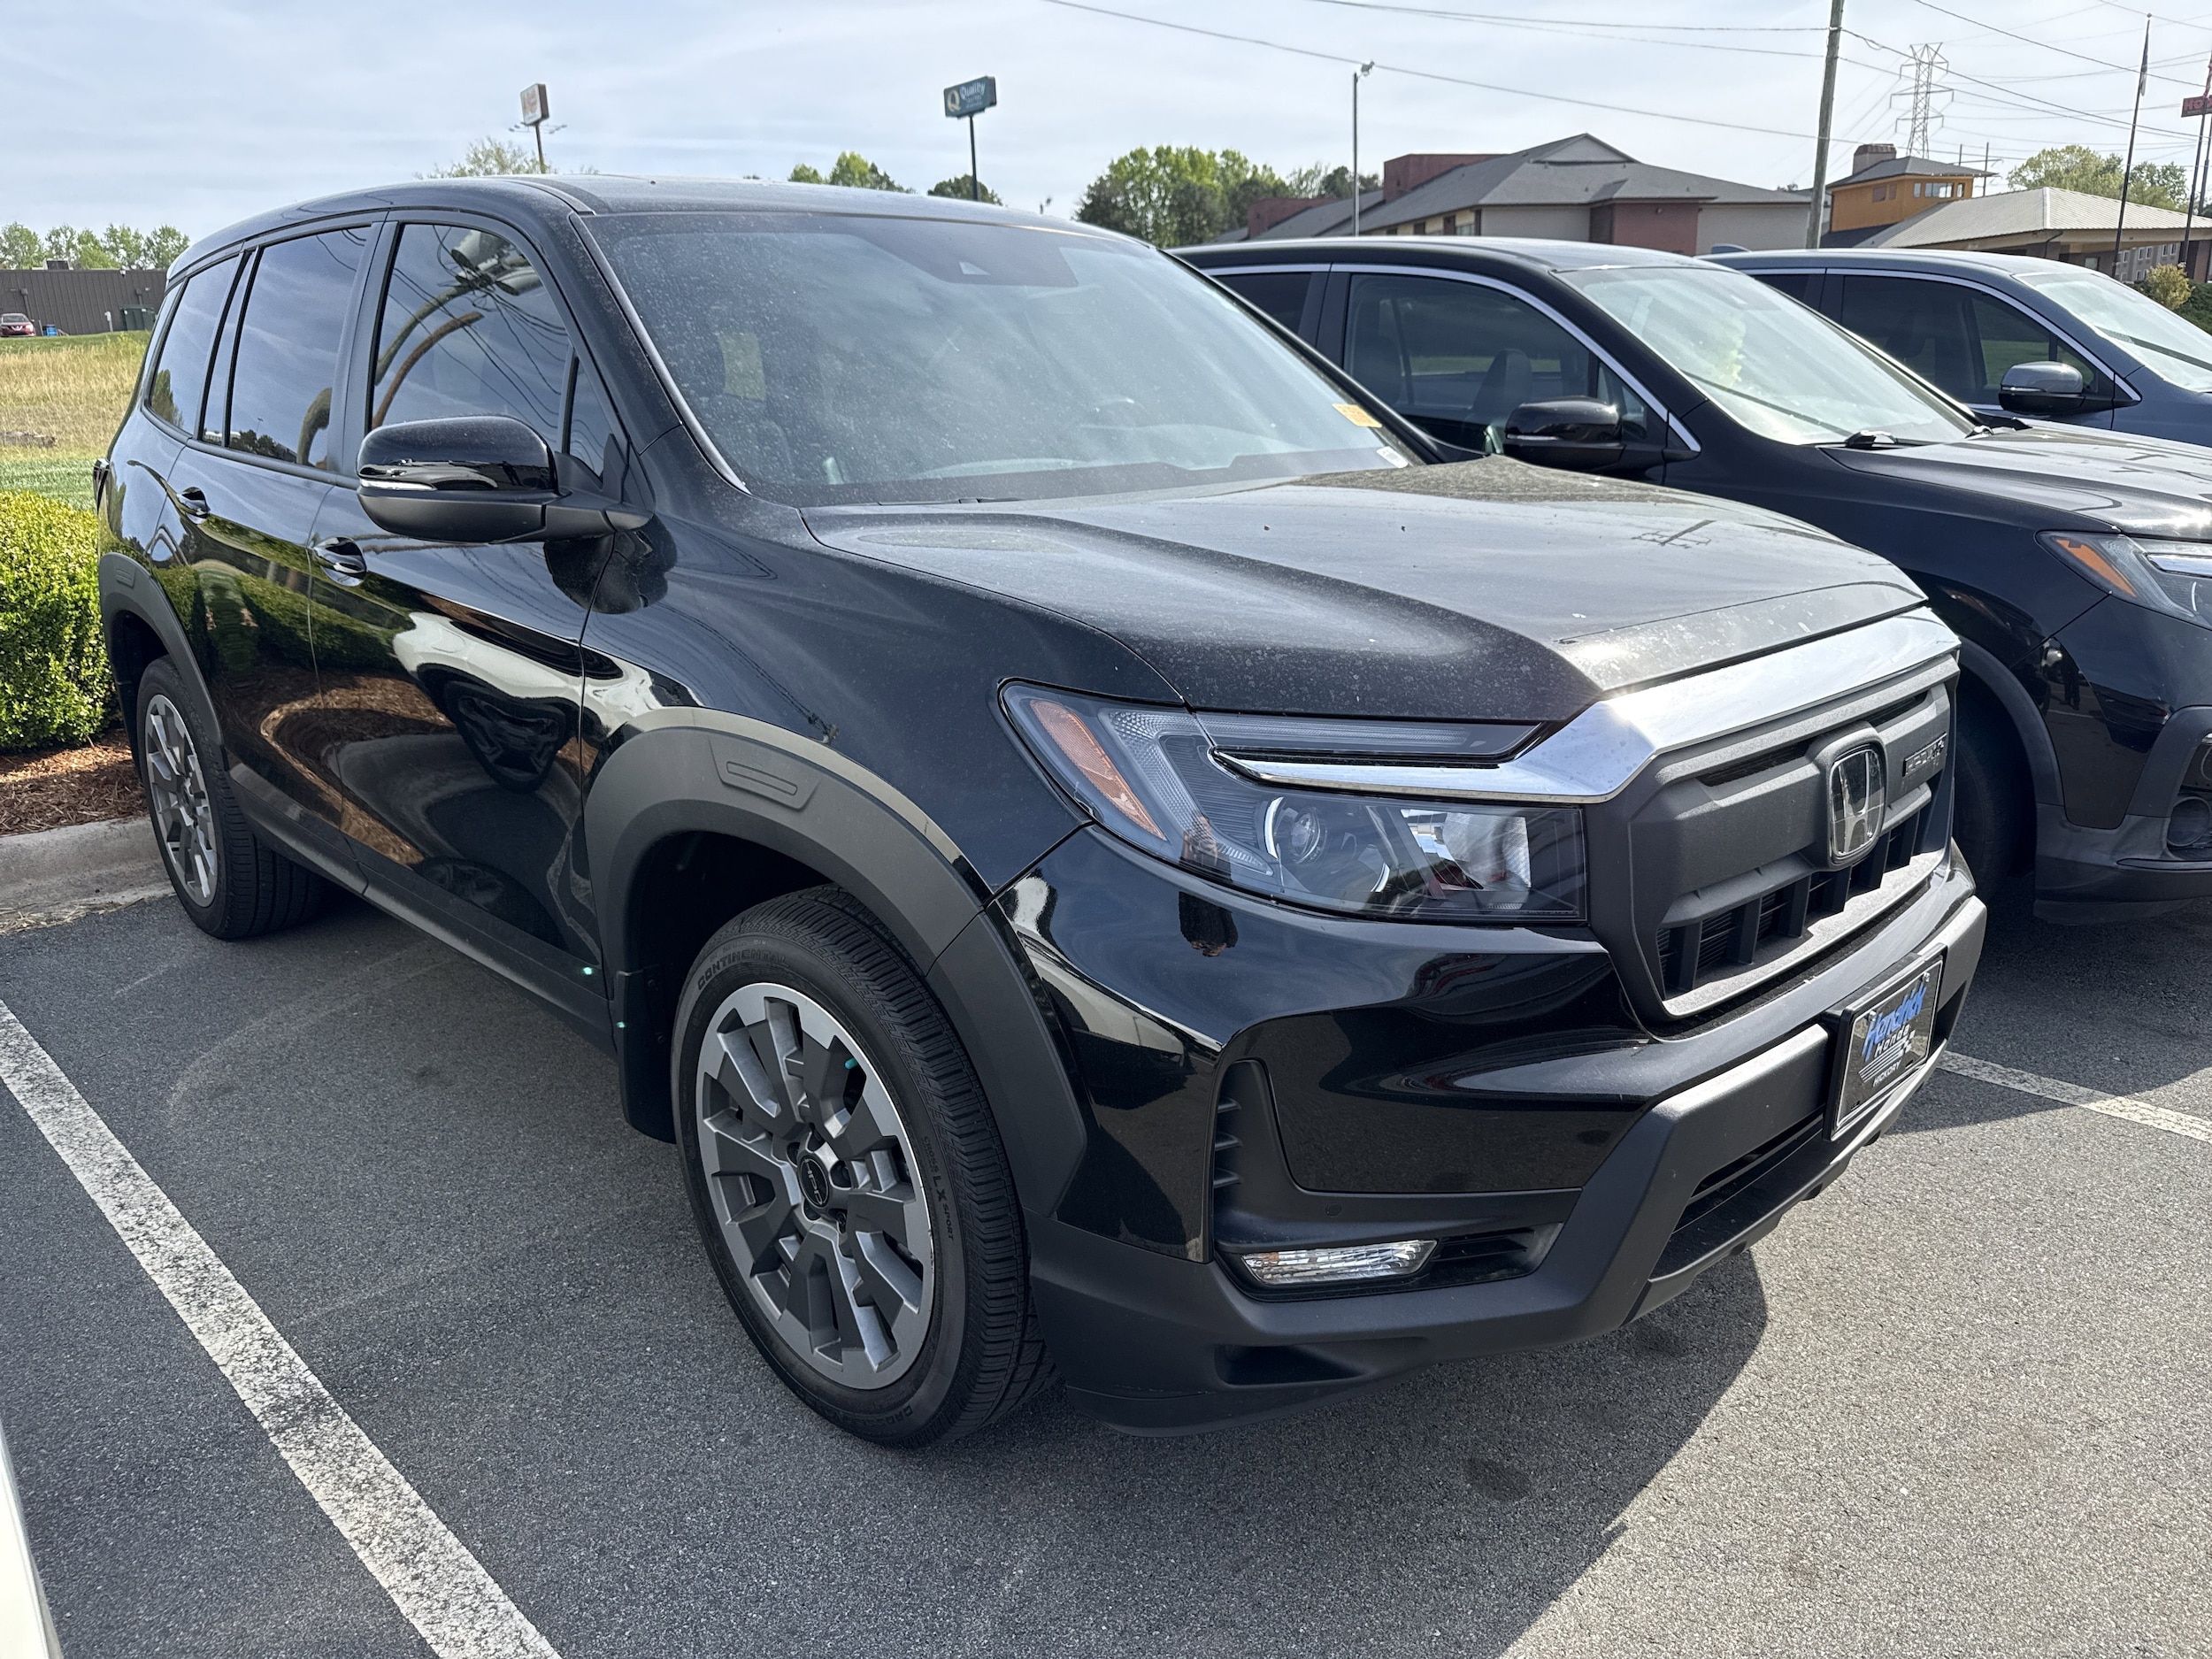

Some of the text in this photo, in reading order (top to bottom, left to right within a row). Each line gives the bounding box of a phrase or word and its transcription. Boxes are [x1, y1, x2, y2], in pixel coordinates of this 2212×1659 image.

[1875, 1024, 1910, 1057] Honda
[1873, 1059, 1901, 1087] HICKORY
[942, 1203, 954, 1240] SPORT
